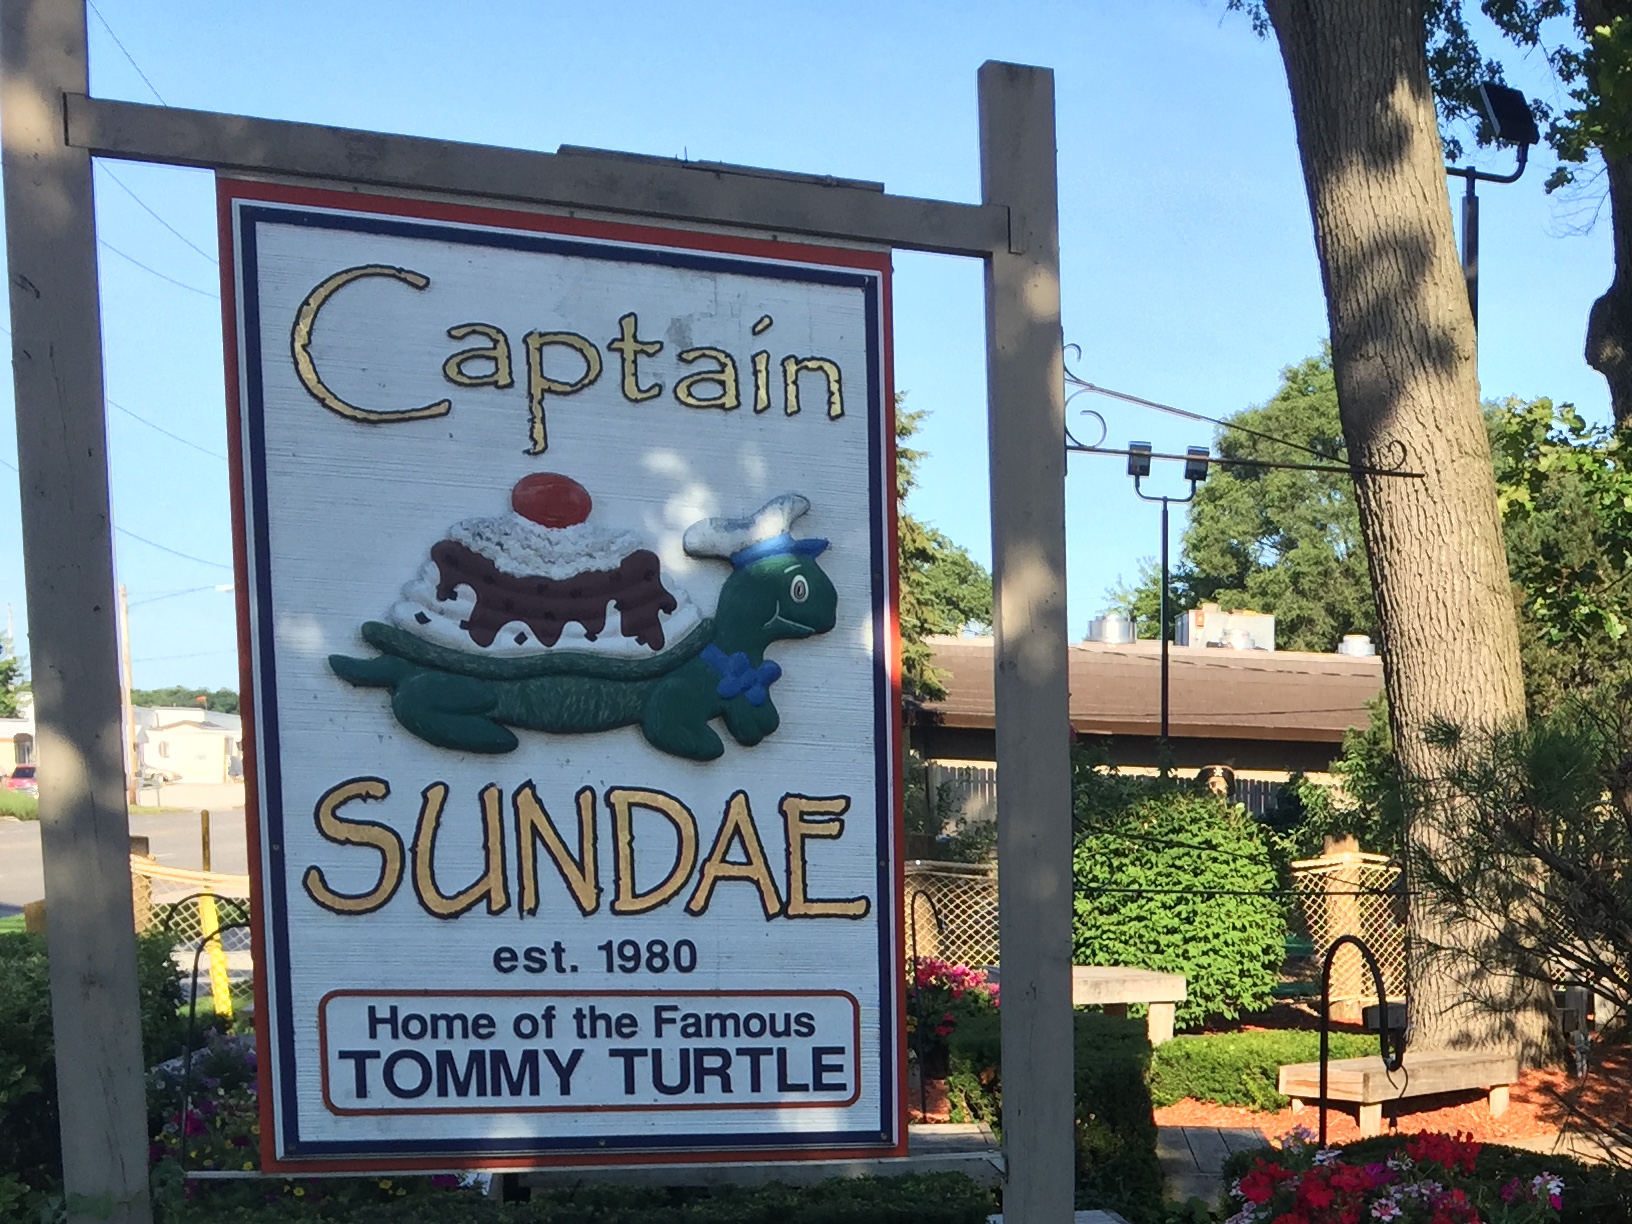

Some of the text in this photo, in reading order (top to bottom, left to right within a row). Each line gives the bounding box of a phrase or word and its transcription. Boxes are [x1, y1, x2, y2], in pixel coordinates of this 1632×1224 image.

[290, 263, 845, 455] Captain
[302, 777, 871, 920] SUNDAE
[493, 938, 697, 974] est. 1980
[367, 1003, 816, 1041] Home of the Famous
[338, 1045, 848, 1099] TOMMY TURTLE
